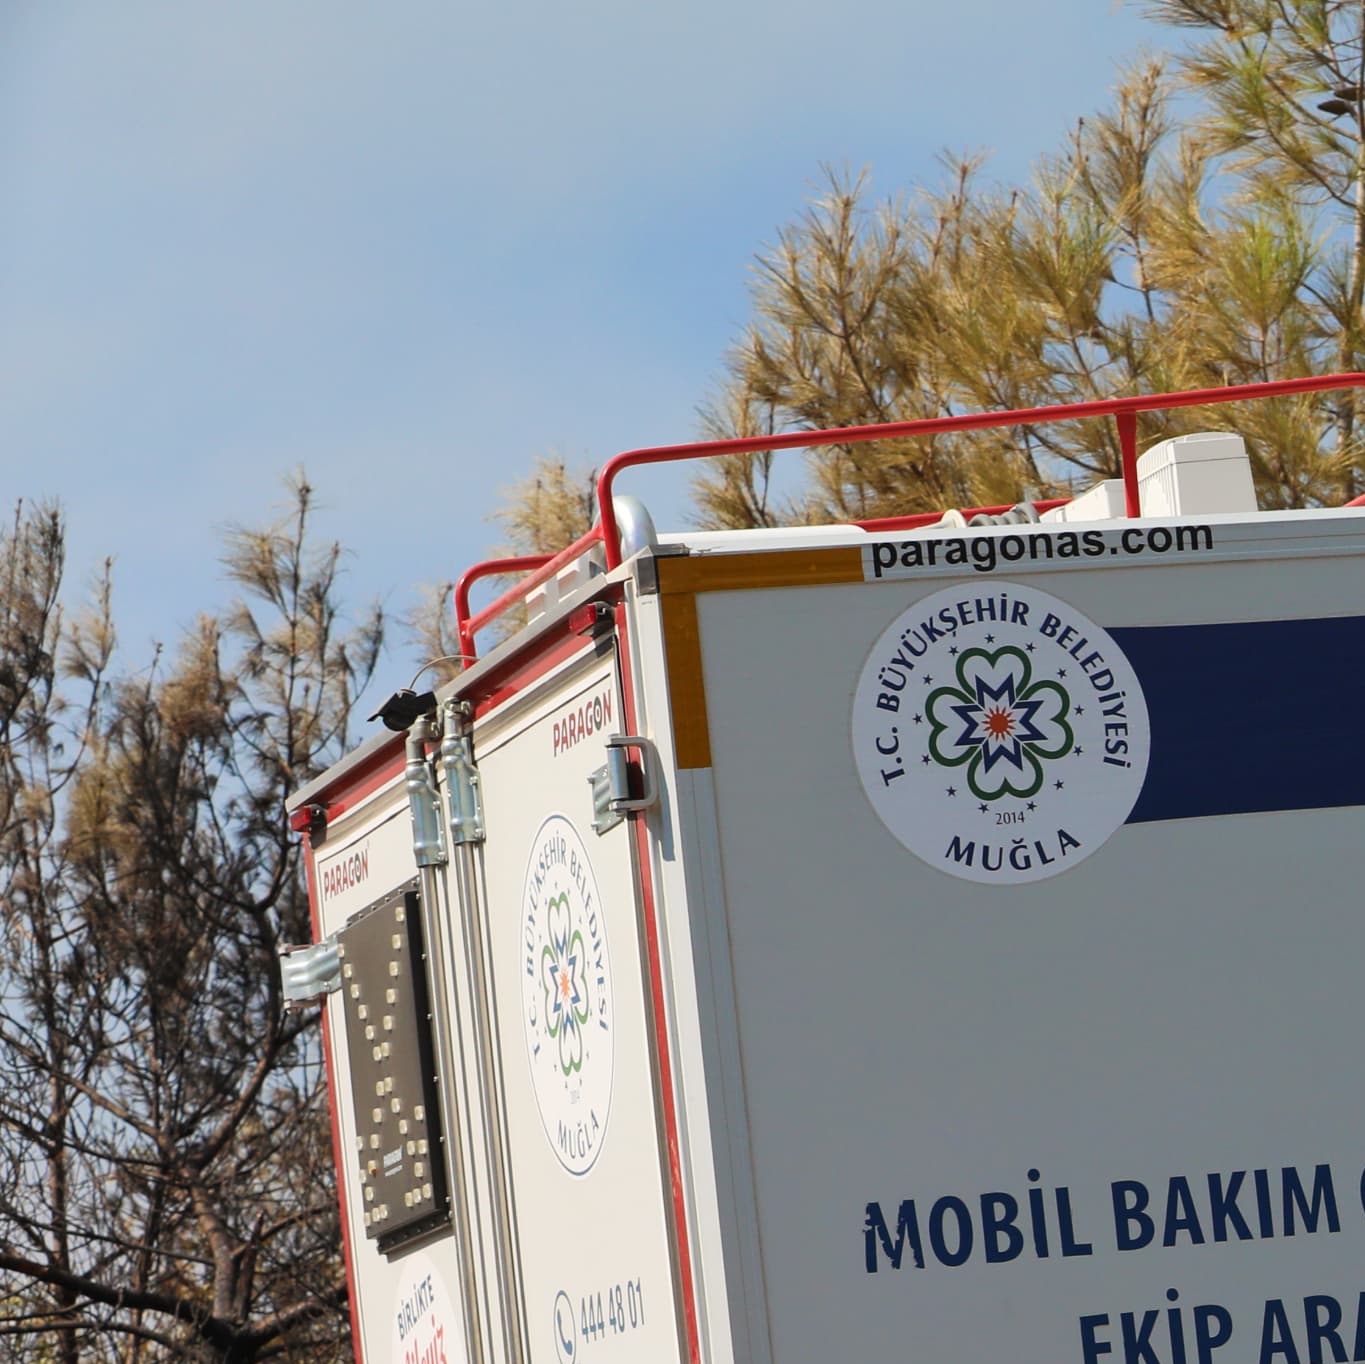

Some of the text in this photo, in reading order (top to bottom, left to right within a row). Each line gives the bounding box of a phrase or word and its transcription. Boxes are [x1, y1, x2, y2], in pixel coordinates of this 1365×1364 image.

[872, 524, 1214, 578] paragonas.com
[553, 688, 612, 757] PARAGON
[876, 593, 1131, 787] T.C. BÜYÜKŞEHİR BELEDİYESİ
[944, 828, 1082, 872] MUĞLA
[995, 811, 1026, 825] 2014
[323, 848, 369, 902] PARAGON
[863, 1168, 1093, 1274] MOBİL
[1111, 1163, 1341, 1252] BAKIM
[397, 1273, 435, 1341] BİRLİKTE
[581, 1276, 645, 1344] 444 48 01
